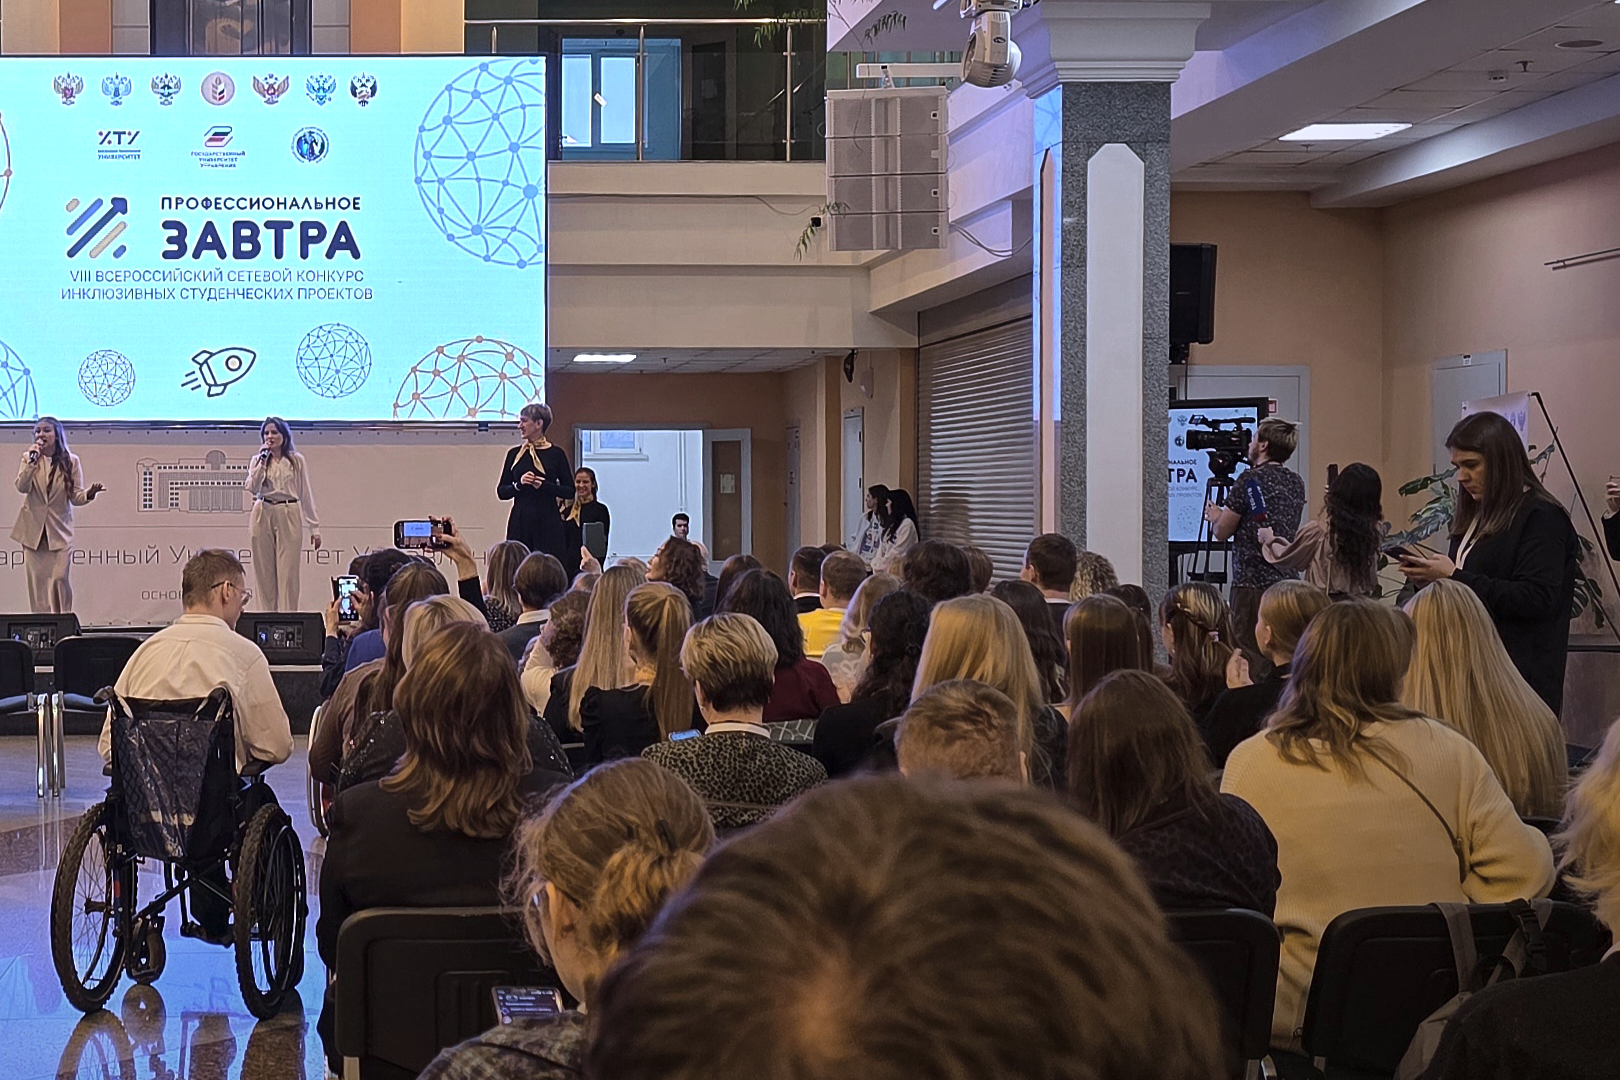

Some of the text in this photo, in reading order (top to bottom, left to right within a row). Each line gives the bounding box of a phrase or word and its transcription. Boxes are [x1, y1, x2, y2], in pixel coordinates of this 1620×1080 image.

[161, 196, 361, 210] ПРОФЕССИОНАЛЬНОЕ
[161, 220, 361, 260] ЗАВТРА
[70, 268, 364, 282] VIII ВСЕРОССИЙСКИЙ СЕТЕВОЙ КОНКУРС
[61, 287, 373, 302] ИНКЛЮЗИВНЫХ СТУДЕНЧЕСКИХ ПРОЕКТОВ
[1168, 468, 1198, 483] ТРА
